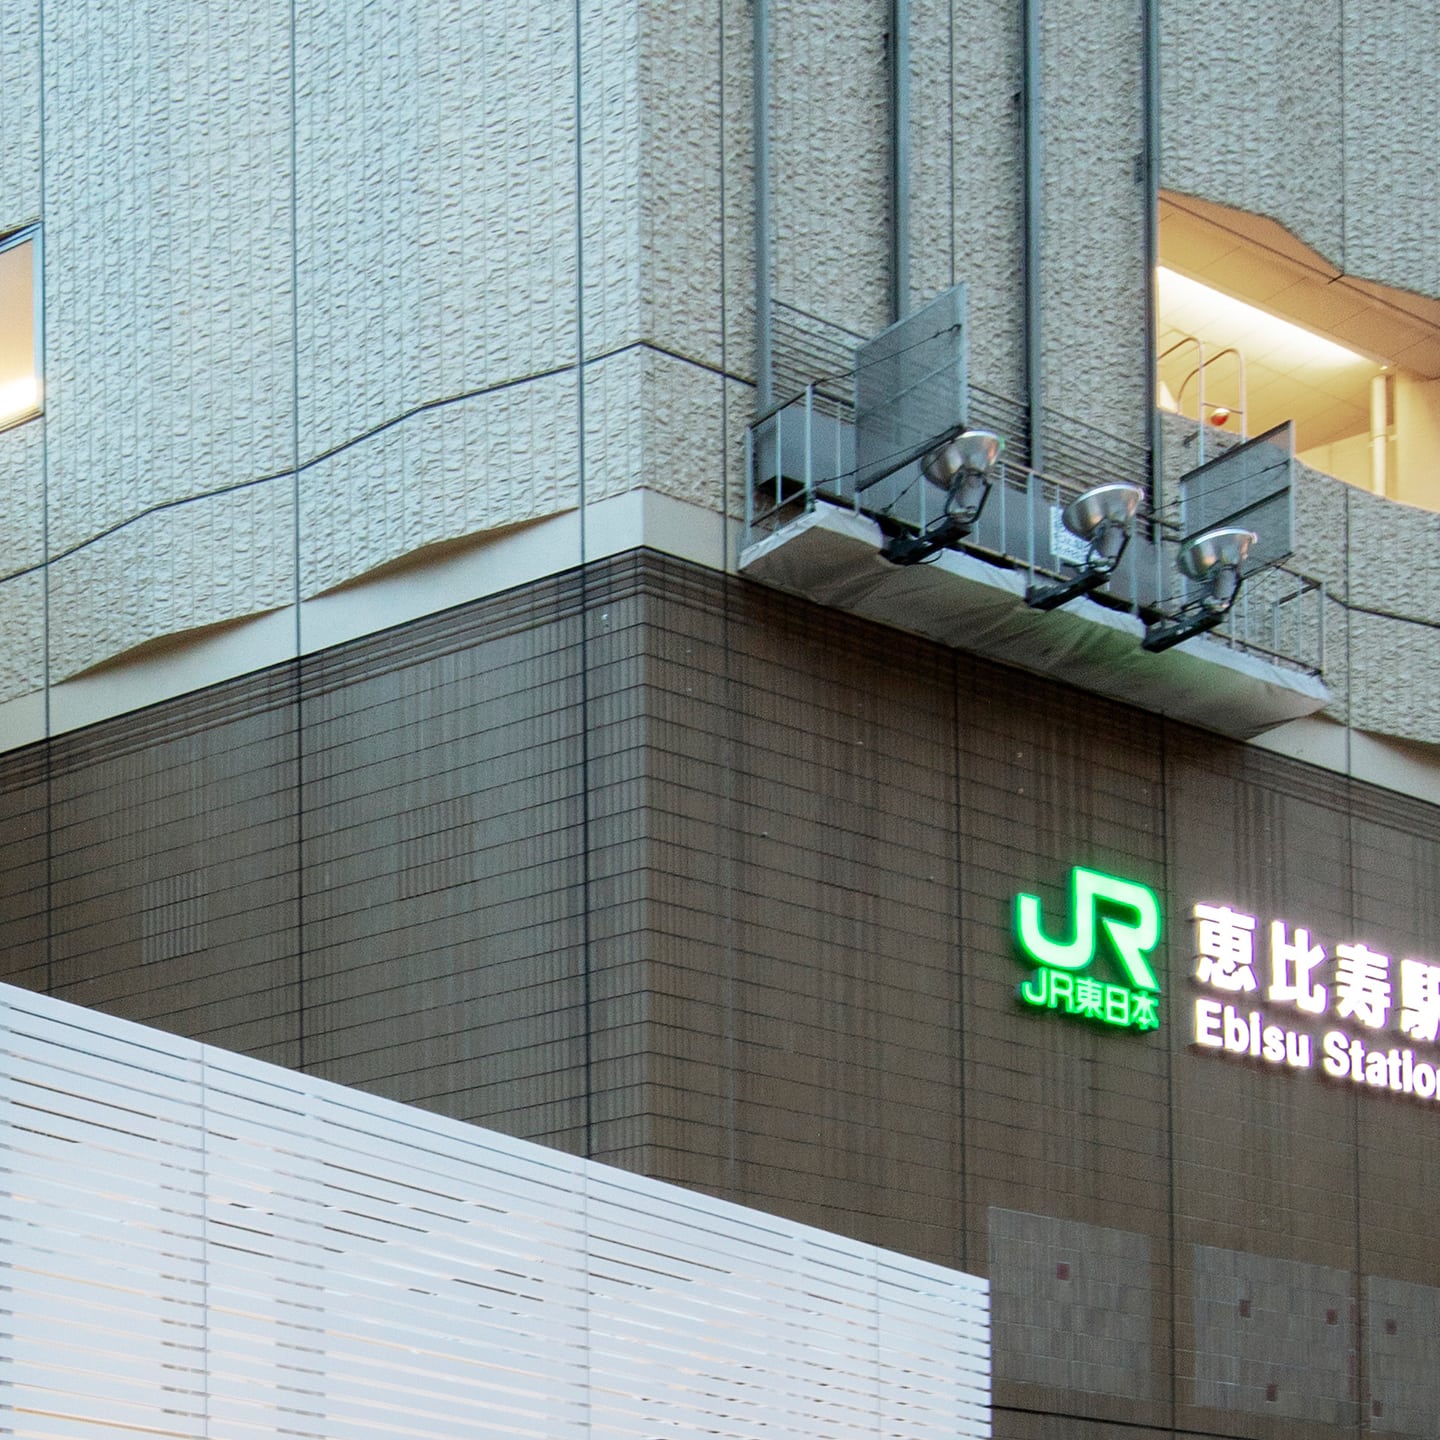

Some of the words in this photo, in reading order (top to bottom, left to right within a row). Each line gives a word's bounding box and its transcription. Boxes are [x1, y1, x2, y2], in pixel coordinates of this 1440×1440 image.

[1016, 866, 1161, 990] JR
[1021, 967, 1160, 1030] JR東日本
[1195, 998, 1312, 1068] Ebisu
[1323, 1030, 1440, 1101] Statio
